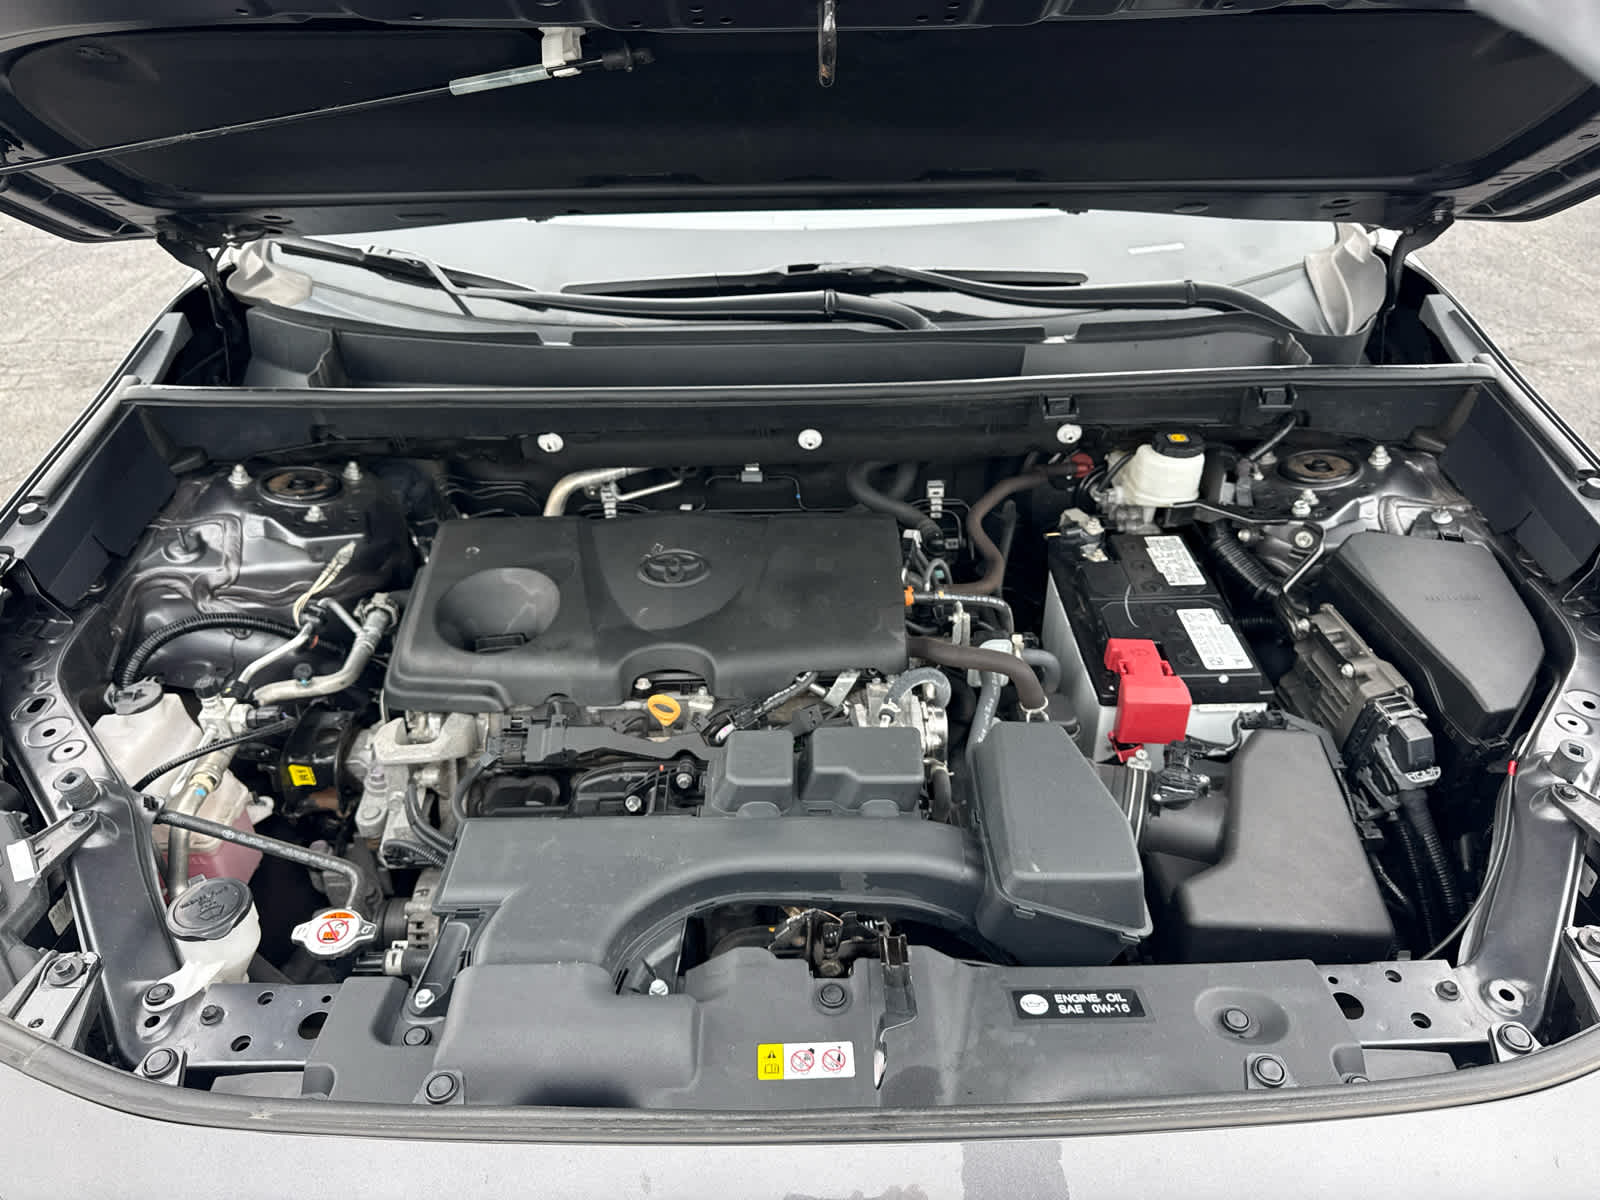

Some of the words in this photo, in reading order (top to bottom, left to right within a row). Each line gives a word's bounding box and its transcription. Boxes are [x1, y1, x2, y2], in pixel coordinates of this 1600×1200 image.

[1054, 993, 1101, 1003] ENGINE
[1105, 992, 1127, 1003] OIL
[1058, 1003, 1084, 1014] SAE
